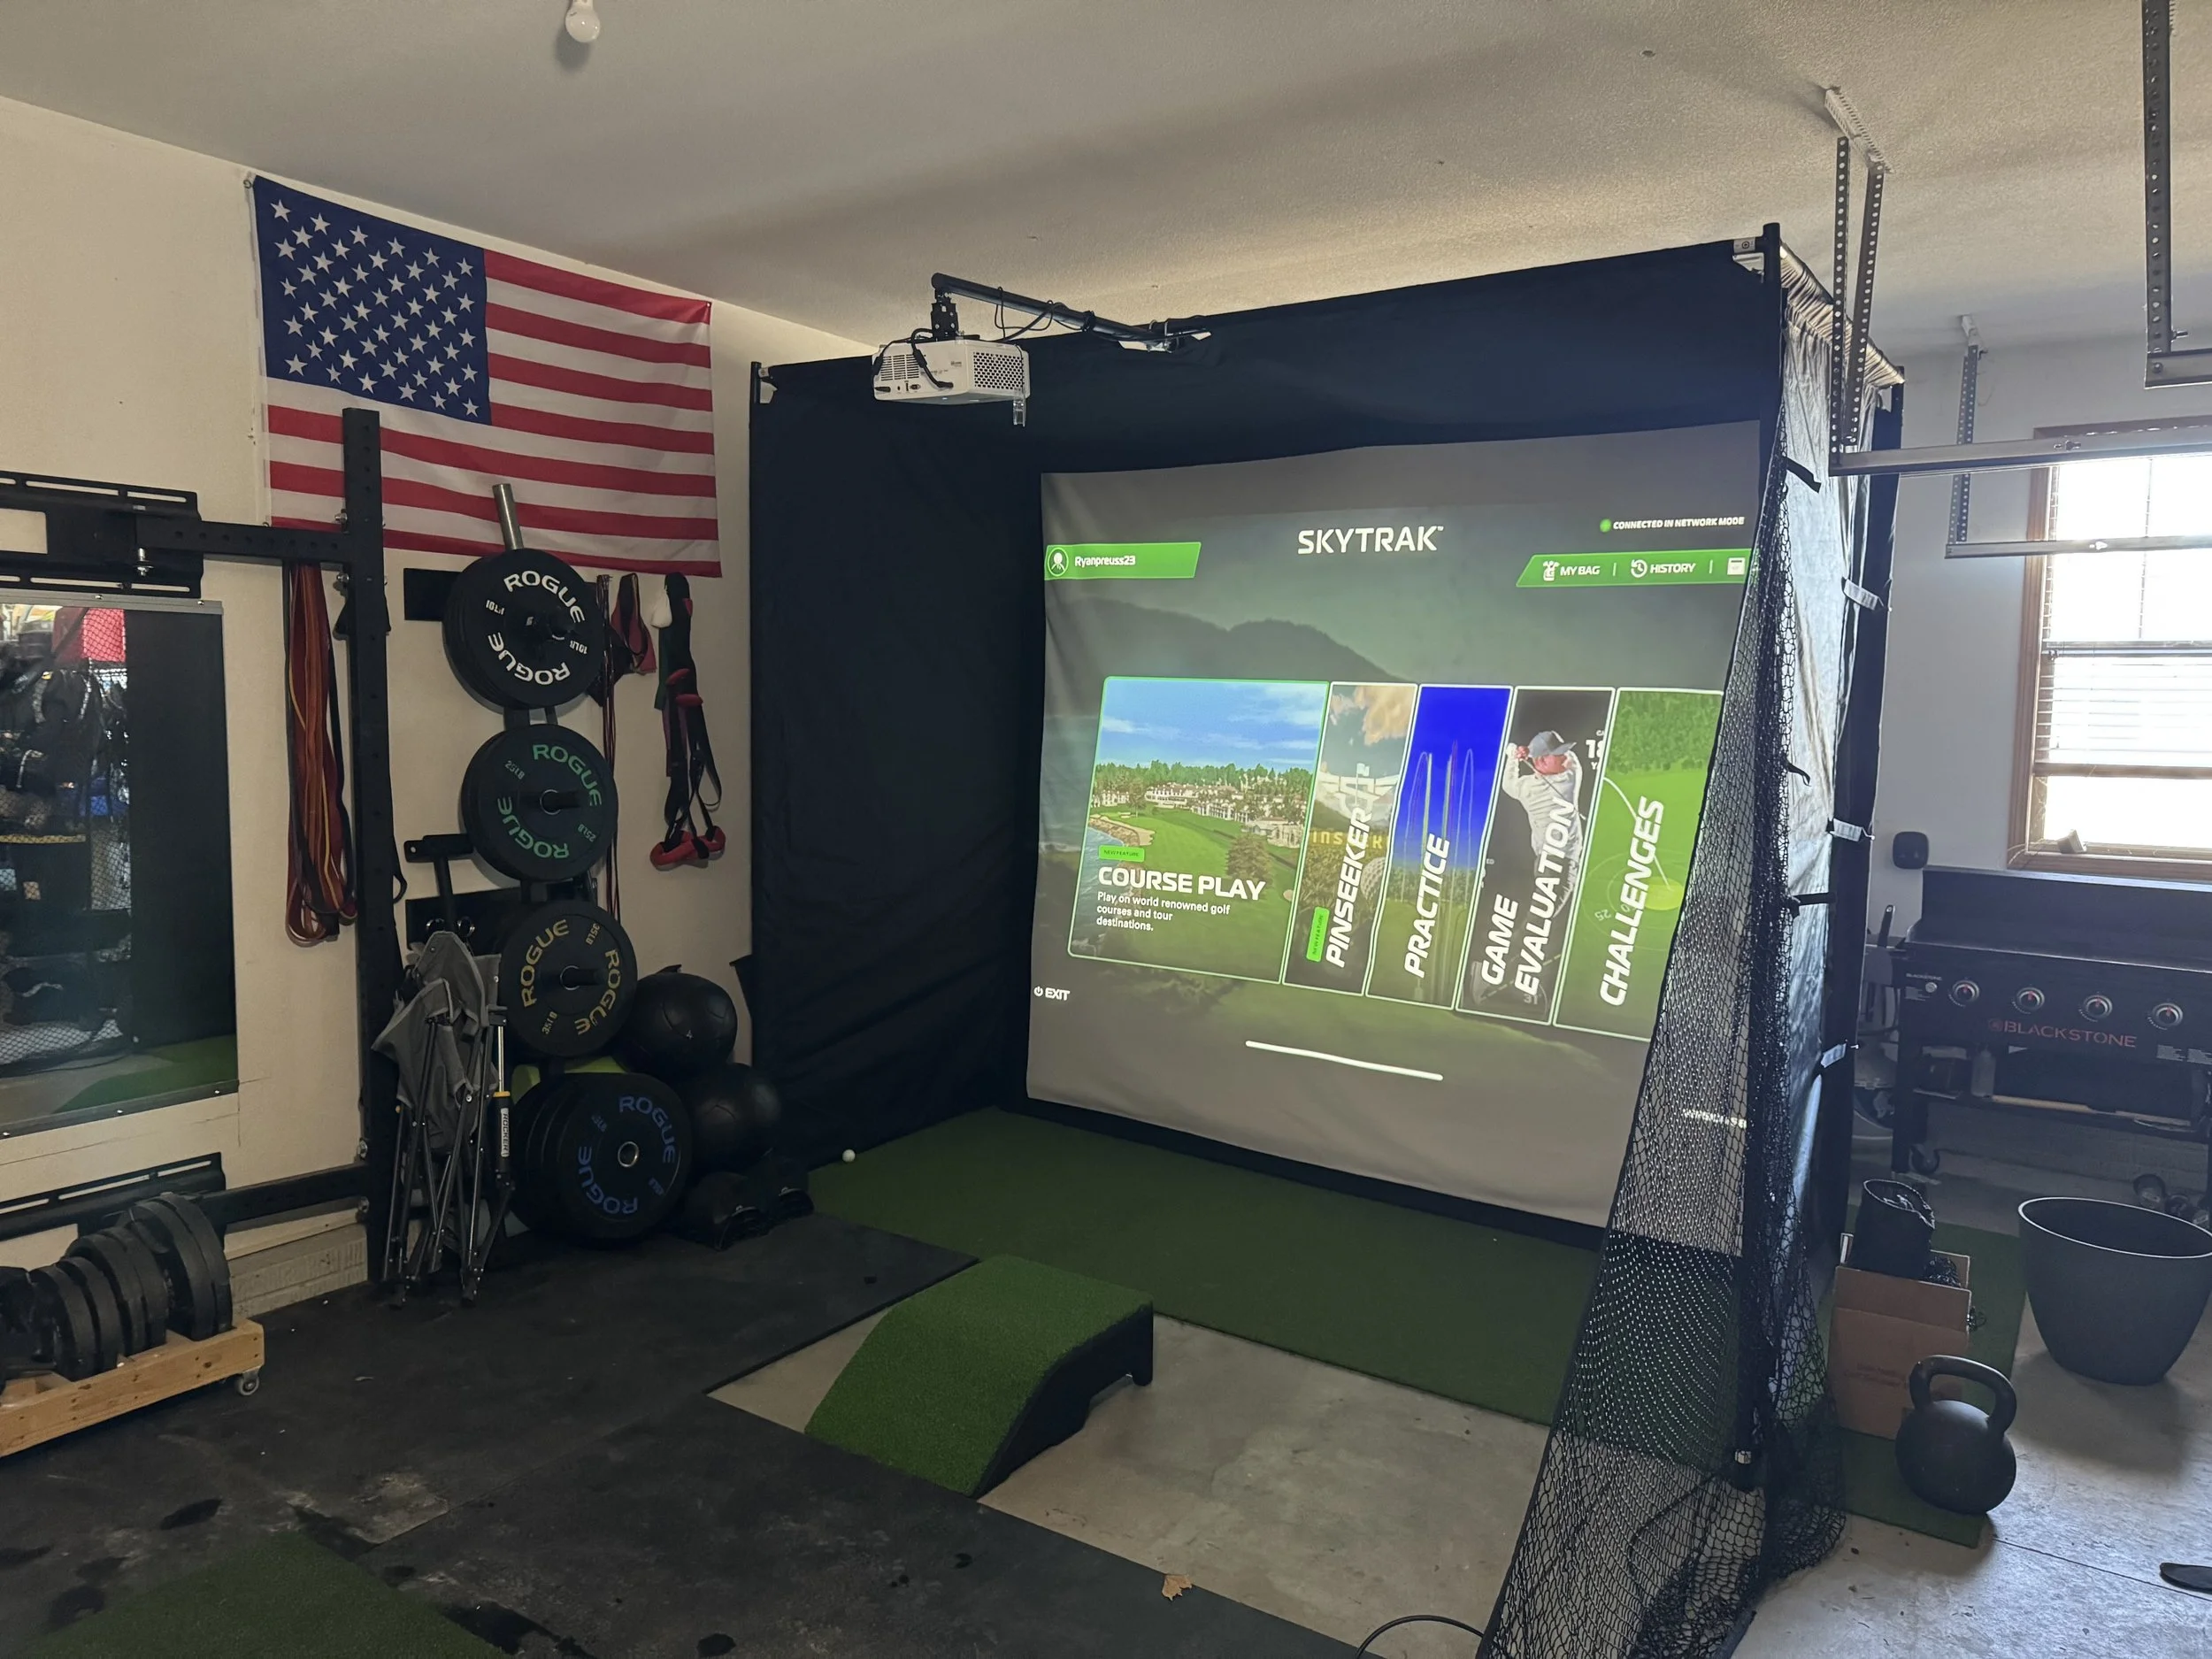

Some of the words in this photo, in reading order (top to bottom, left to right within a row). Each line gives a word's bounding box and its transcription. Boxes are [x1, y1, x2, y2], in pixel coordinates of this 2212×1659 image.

[1613, 521, 1663, 530] CONNECTED
[1663, 519, 1674, 528] IN
[1675, 518, 1717, 527] NETWORK
[1718, 517, 1746, 526] MODE
[1298, 526, 1438, 554] SKYTRAK
[1074, 555, 1136, 567] Ryanpreuss23
[1560, 566, 1578, 576] MY
[1578, 565, 1601, 575] BAG
[1650, 563, 1696, 573] HISTORY
[503, 570, 585, 623] ROGUE
[488, 632, 571, 685] ROGUE
[569, 640, 588, 655] 10LB
[504, 760, 526, 780] 25LB
[532, 744, 602, 807] ROGUE
[497, 795, 569, 859] ROGUE
[577, 823, 596, 842] 25LB
[1098, 866, 1193, 894] COURSE
[1197, 875, 1266, 901] PLAY
[1325, 807, 1371, 969] PINSEEKER
[1514, 796, 1575, 996] EVALUATION
[1096, 905, 1132, 918] courses
[1133, 909, 1151, 919] and
[1153, 910, 1173, 922] tour
[1097, 891, 1117, 904] Play
[1118, 895, 1131, 904] on
[1132, 896, 1159, 908] world
[1161, 899, 1209, 913] renowned
[1210, 904, 1231, 916] golf
[1404, 833, 1450, 979] PRACTICE
[1600, 796, 1664, 1007] CHALLENGES
[585, 923, 601, 945] 35LB
[1096, 916, 1154, 932] destinations.
[1481, 894, 1519, 986] GAME
[520, 919, 570, 1008] ROGUE
[574, 949, 621, 1035] ROGUE
[1045, 987, 1071, 1001] EXIT
[2003, 1021, 2137, 1048] BLACKSTONE
[619, 1095, 675, 1164] ROGUE
[578, 1146, 638, 1215] ROGUE
